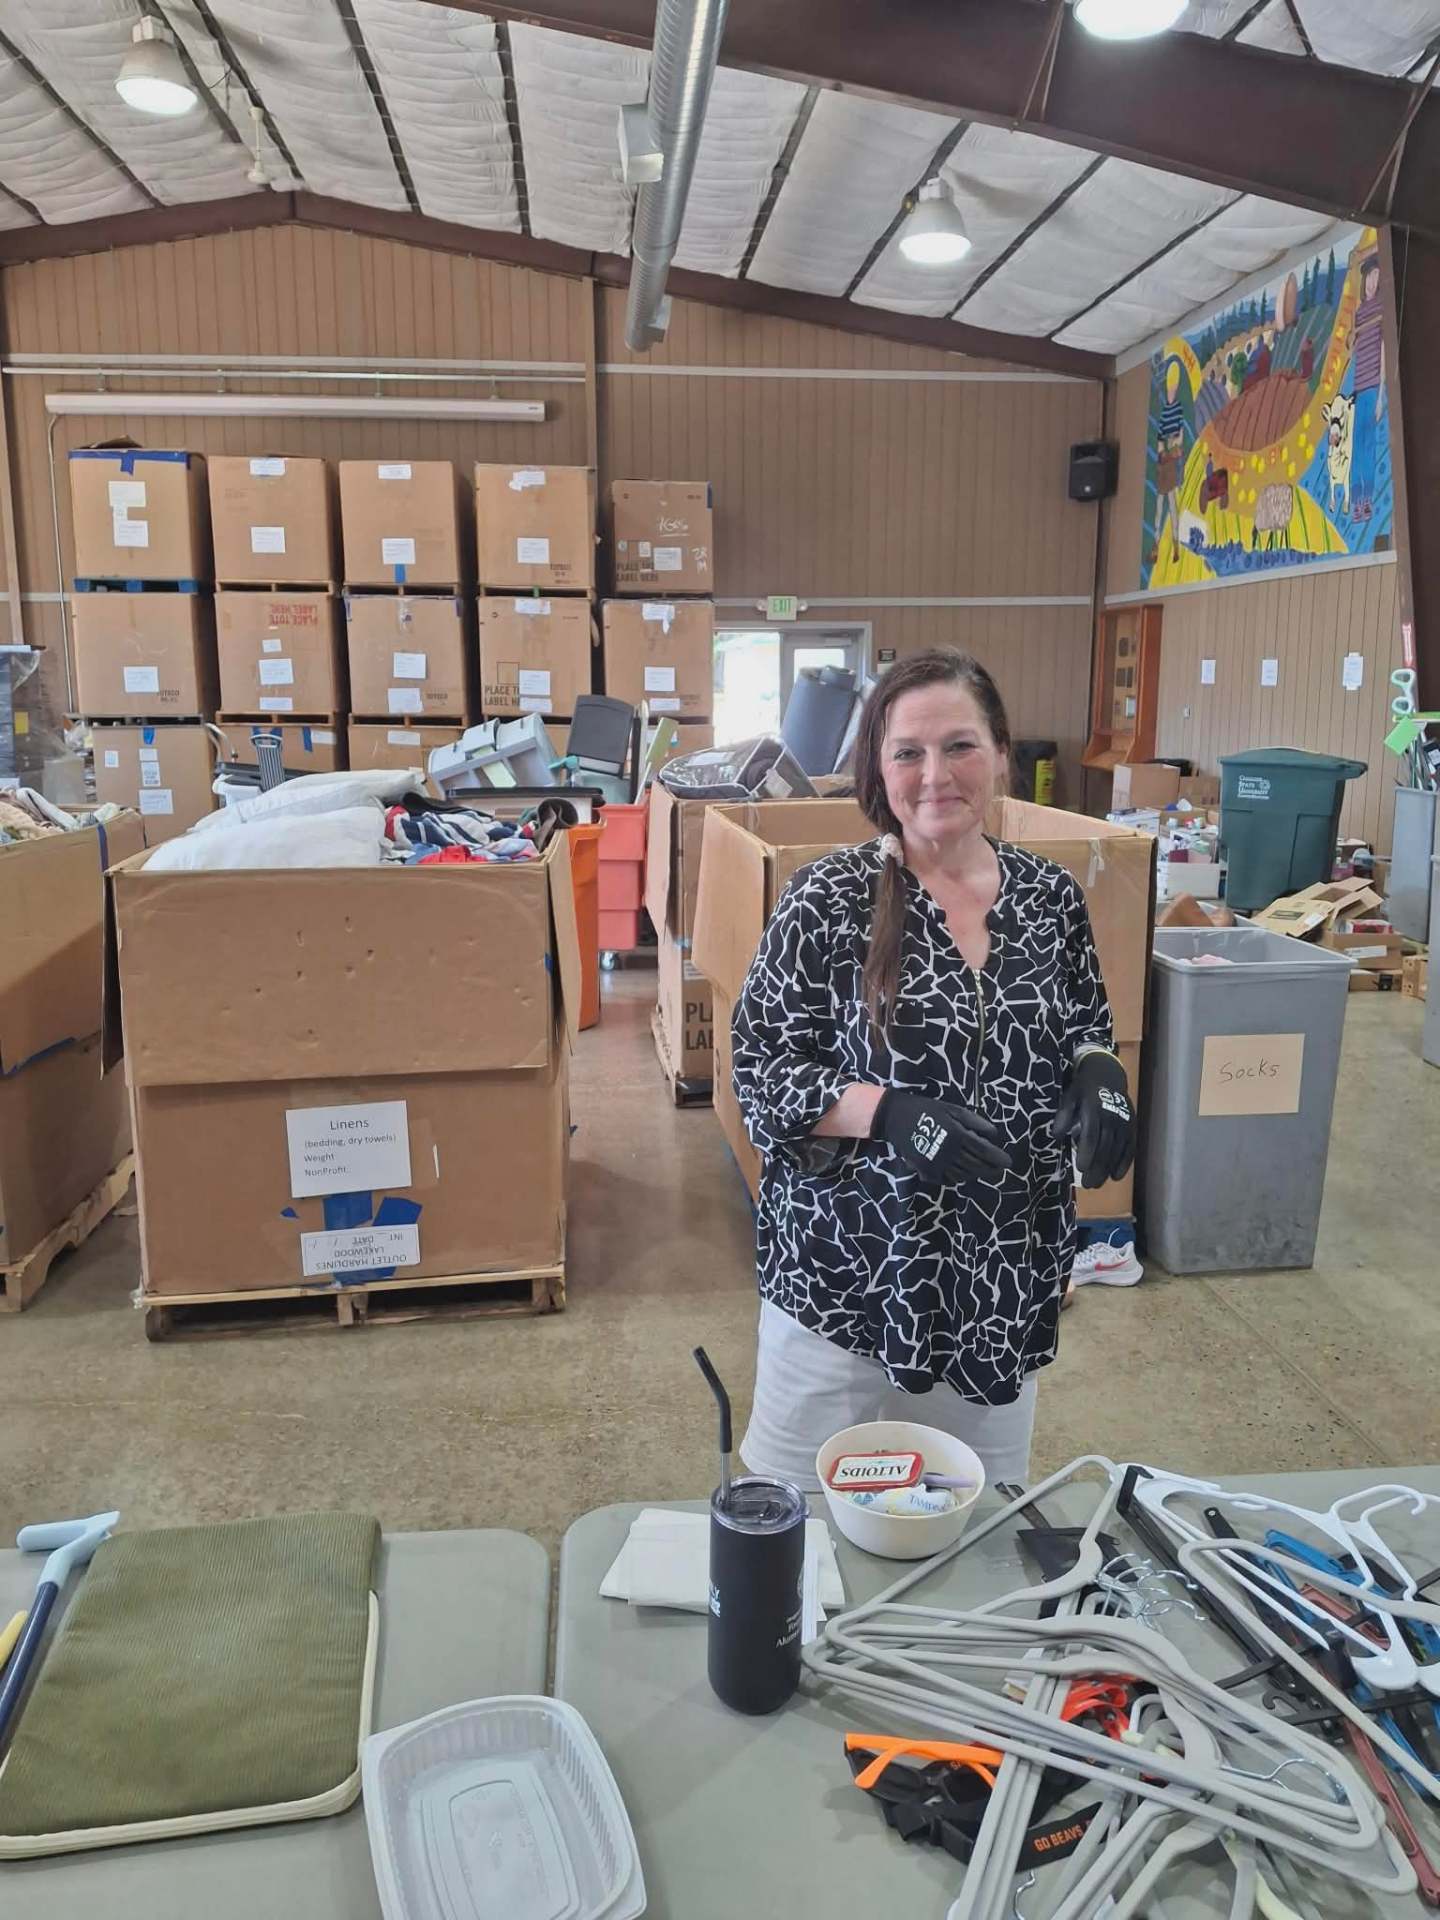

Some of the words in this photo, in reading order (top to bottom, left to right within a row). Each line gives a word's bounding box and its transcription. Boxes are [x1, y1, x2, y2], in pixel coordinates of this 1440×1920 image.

[484, 686, 509, 696] PLACE
[484, 696, 509, 705] LABEL
[686, 1001, 713, 1023] PL
[330, 1119, 370, 1131] Linens
[304, 1138, 346, 1149] (bedding,
[347, 1137, 363, 1146] dry
[365, 1133, 397, 1144] towels)
[304, 1152, 335, 1163] Weight
[352, 1234, 374, 1245] DATE
[334, 1246, 385, 1258] LAKEWOOD
[316, 1256, 368, 1271] HARDLINES
[372, 1254, 407, 1265] OUTLET
[840, 1464, 908, 1478] ALTOIDS
[1033, 1836, 1051, 1852] GO
[1050, 1824, 1084, 1846] BEAVS
